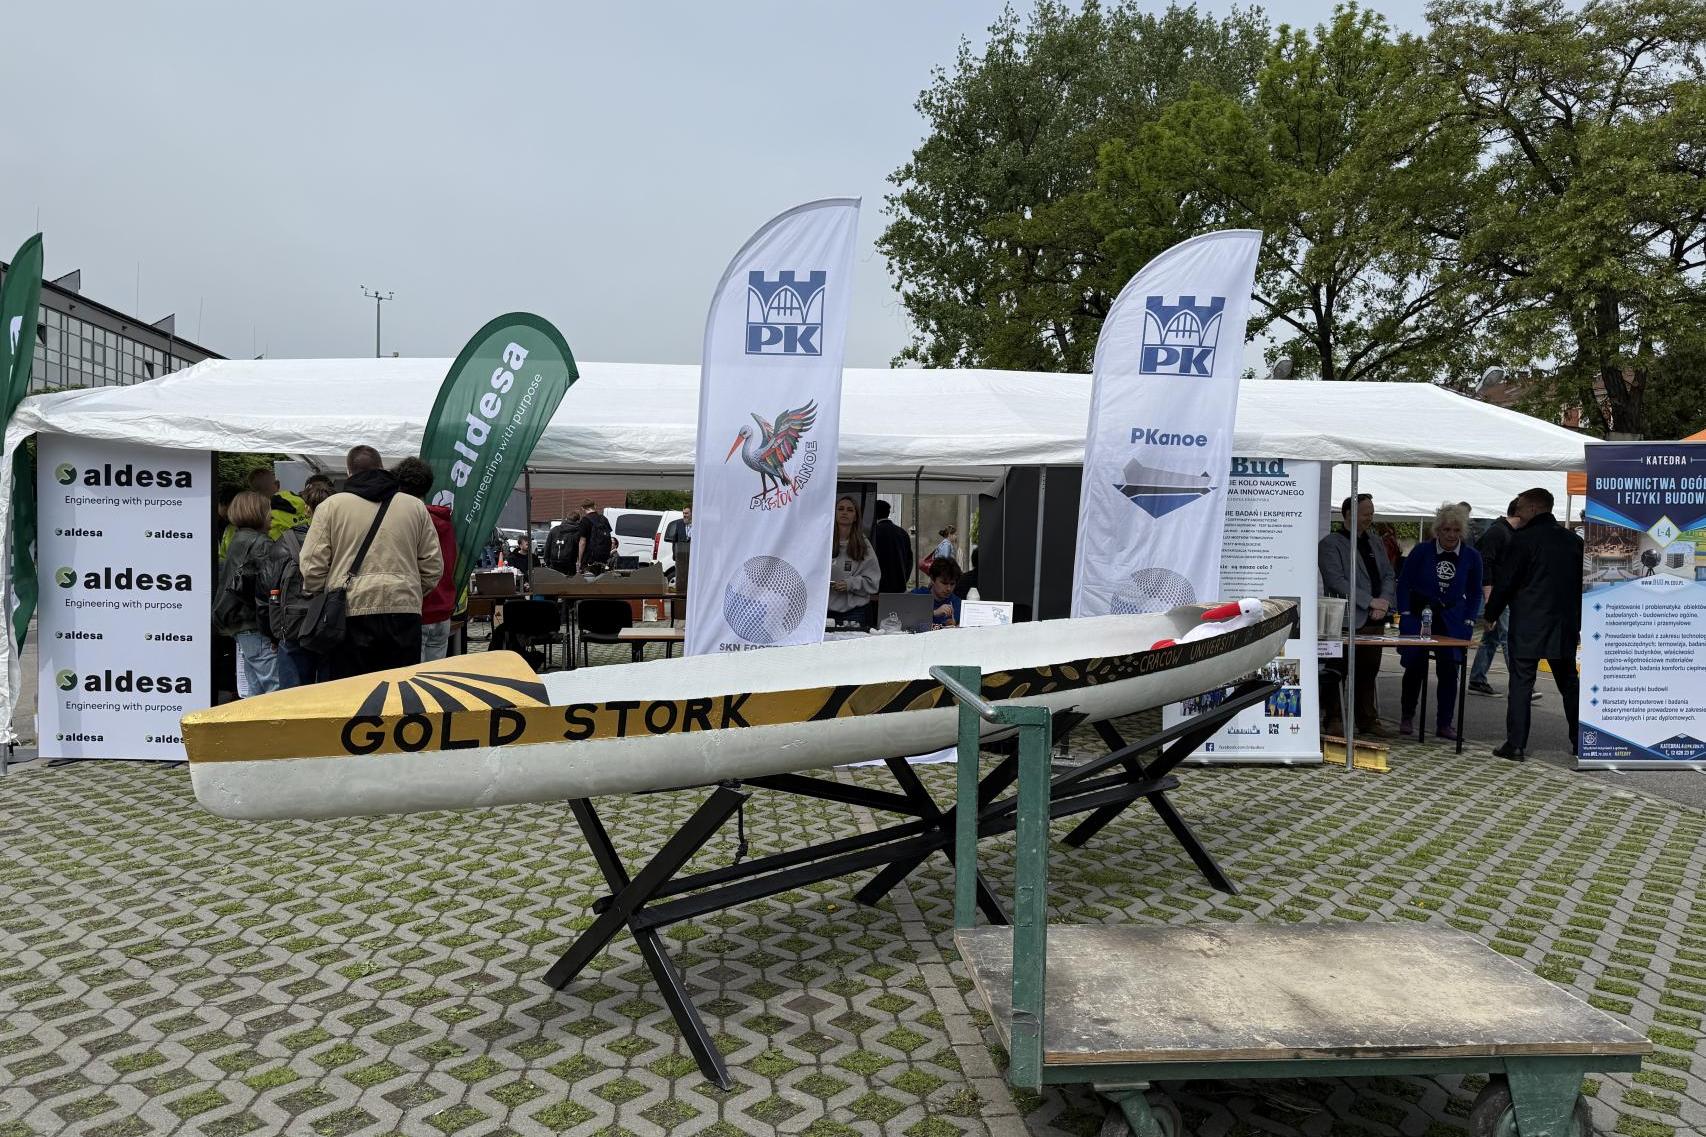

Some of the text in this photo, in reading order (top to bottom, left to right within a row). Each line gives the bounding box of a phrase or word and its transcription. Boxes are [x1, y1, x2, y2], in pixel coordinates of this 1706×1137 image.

[748, 326, 820, 354] PK
[1142, 346, 1214, 375] PK
[450, 342, 530, 488] aldesa
[1130, 428, 1208, 447] PKanoe
[466, 374, 542, 524] Engineering with purpose
[1646, 456, 1686, 465] KATEDRA
[84, 464, 192, 488] aldesa
[1596, 477, 1676, 490] BUDOWNICTWA
[65, 496, 182, 508] Engineering with purpose
[1617, 492, 1706, 504] I FIZYKI BUDOW
[64, 528, 103, 537] aldesa
[154, 530, 193, 539] aldesa
[84, 567, 192, 592] aldesa
[65, 599, 182, 610] Engineering with purpose
[64, 630, 103, 640] aldesa
[154, 632, 193, 642] aldesa
[720, 642, 740, 652] SKN
[1140, 648, 1184, 673] CRACOW
[1190, 632, 1238, 660] UNIVERSITY
[84, 670, 192, 694] aldesa
[66, 701, 182, 713] Engineering with purpose
[341, 692, 753, 756] GOLD STORK
[66, 733, 104, 742] aldesa
[155, 734, 185, 744] aldes
